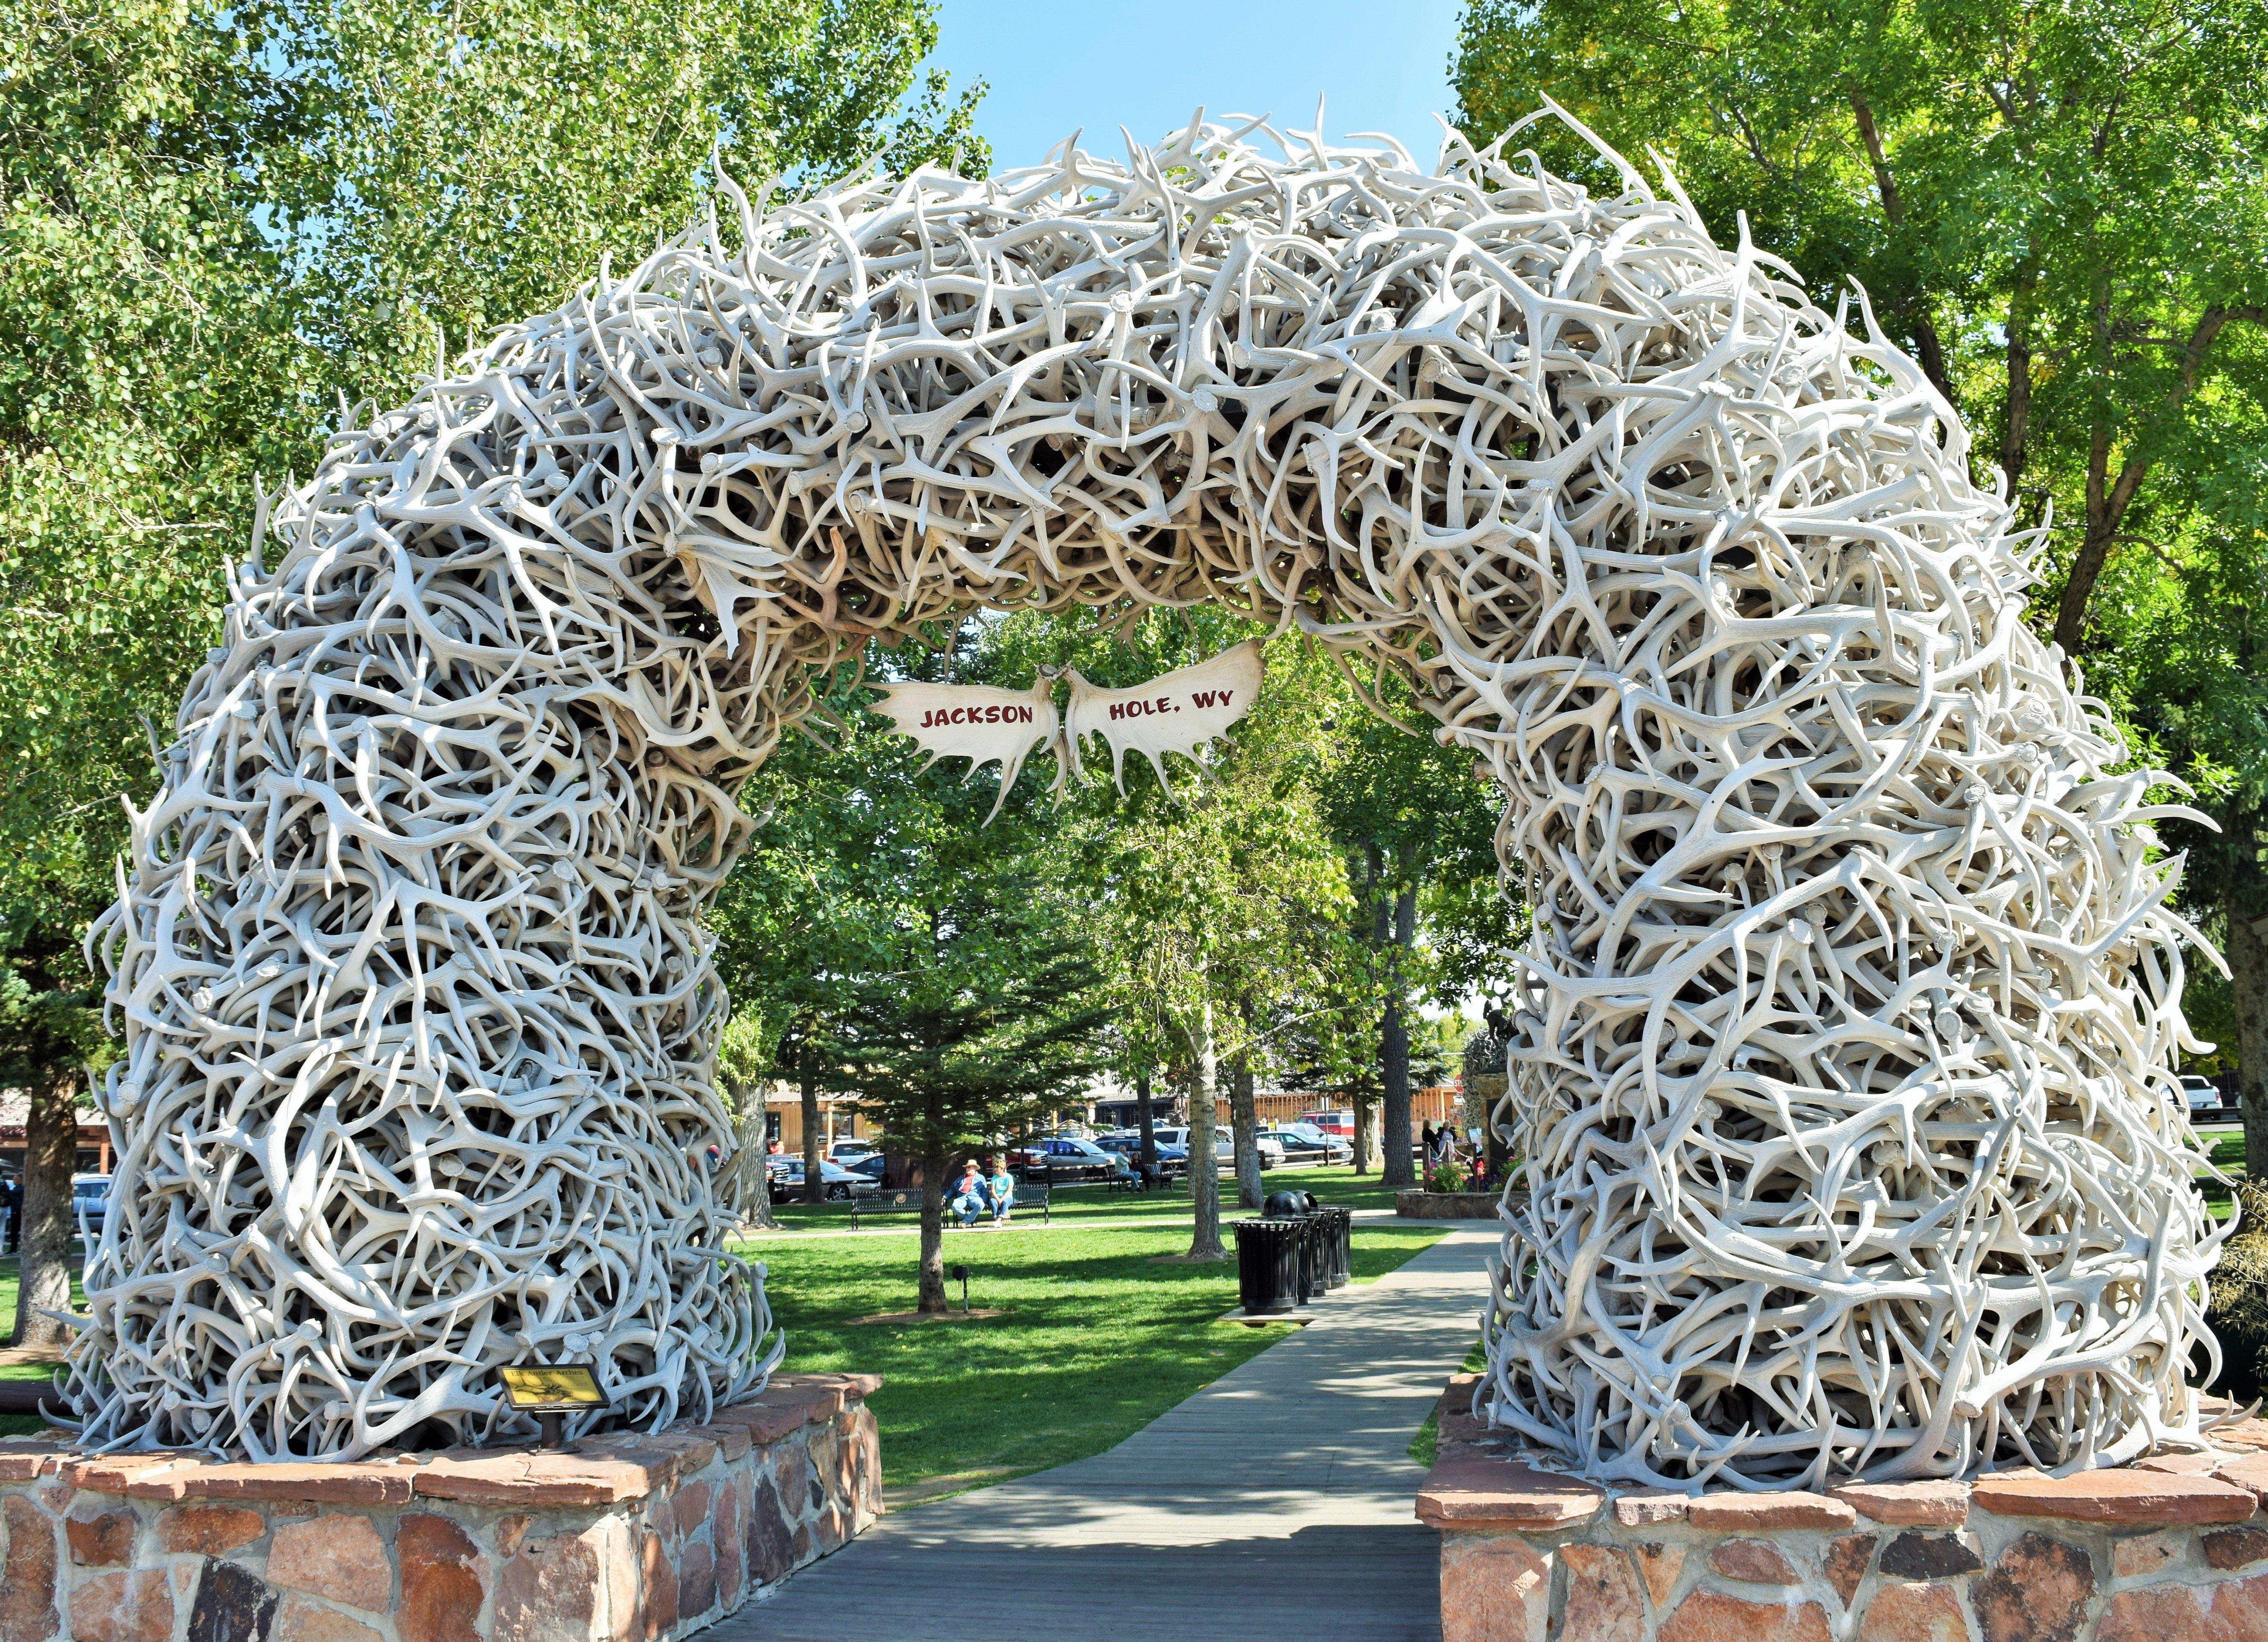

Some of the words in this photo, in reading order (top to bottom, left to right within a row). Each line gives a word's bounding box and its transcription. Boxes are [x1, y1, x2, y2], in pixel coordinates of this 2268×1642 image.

[920, 706, 1032, 728] JACKSON
[1109, 697, 1180, 720] HOLE,
[1192, 690, 1233, 708] WY
